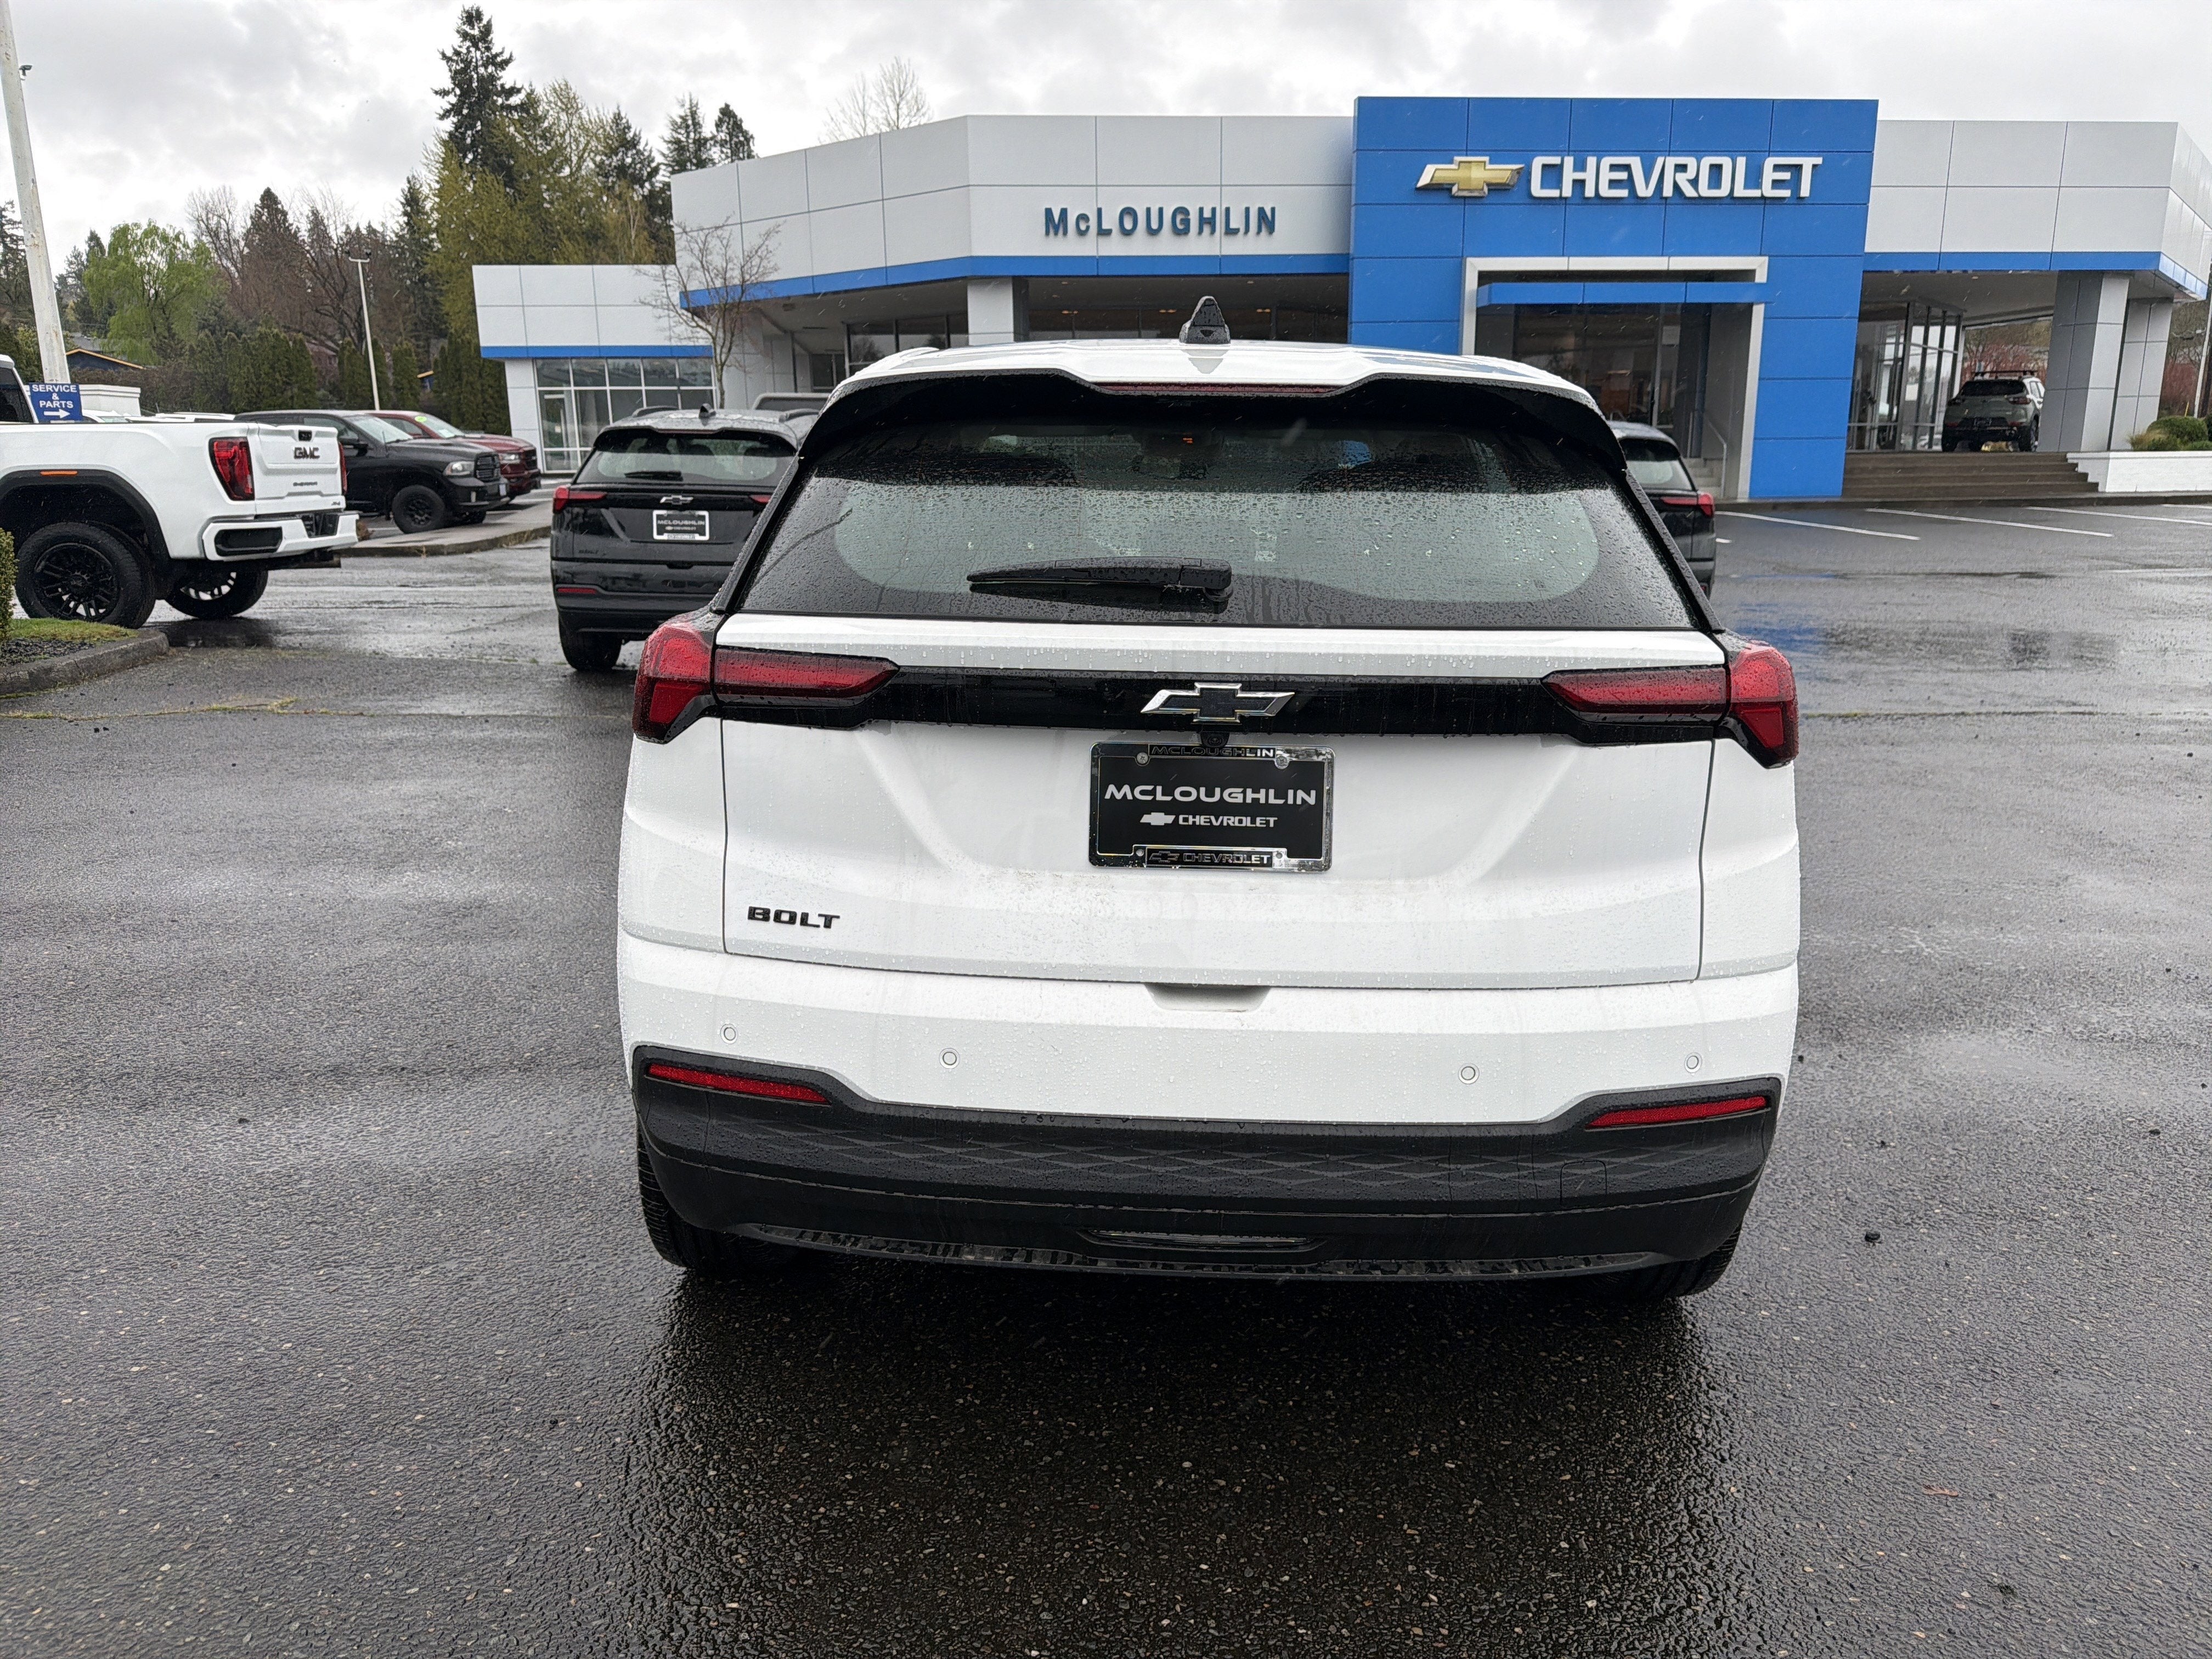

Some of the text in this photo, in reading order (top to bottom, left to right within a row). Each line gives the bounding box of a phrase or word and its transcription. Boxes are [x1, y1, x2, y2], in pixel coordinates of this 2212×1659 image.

[1531, 156, 1822, 198] CHEVROLET
[1045, 206, 1276, 235] McLOUGHLIN
[32, 384, 77, 392] SERVICE
[39, 400, 74, 408] PARTS
[294, 447, 320, 459] GMC
[1151, 746, 1274, 758] MCLOUGHLIN
[1104, 784, 1316, 805] MCLOUGHLIN
[1178, 814, 1278, 827] CHEVROLET
[1183, 853, 1271, 864] CHEVROLET
[747, 906, 840, 929] BOLT
